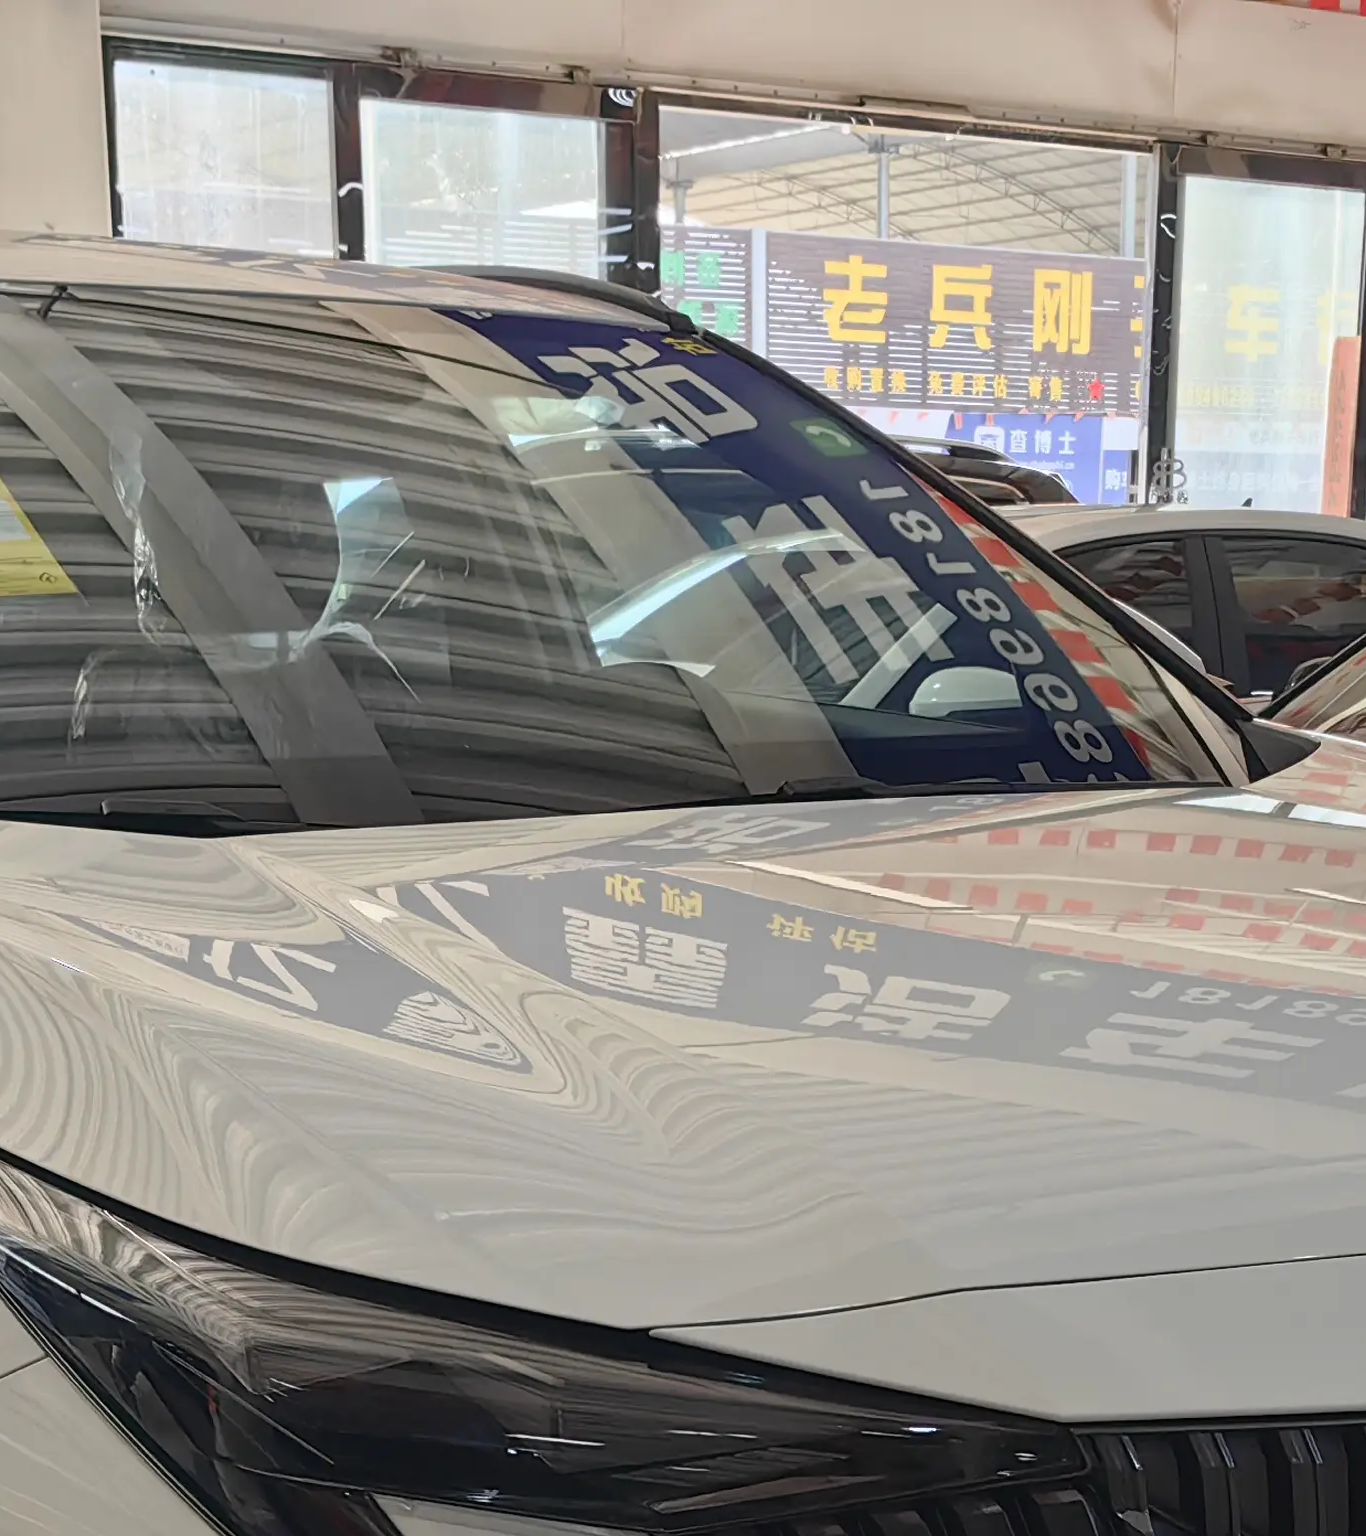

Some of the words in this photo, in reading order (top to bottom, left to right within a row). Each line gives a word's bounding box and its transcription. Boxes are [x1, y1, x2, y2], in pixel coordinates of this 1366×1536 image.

[823, 255, 1143, 357] 老兵刚
[1009, 429, 1076, 455] 查博士
